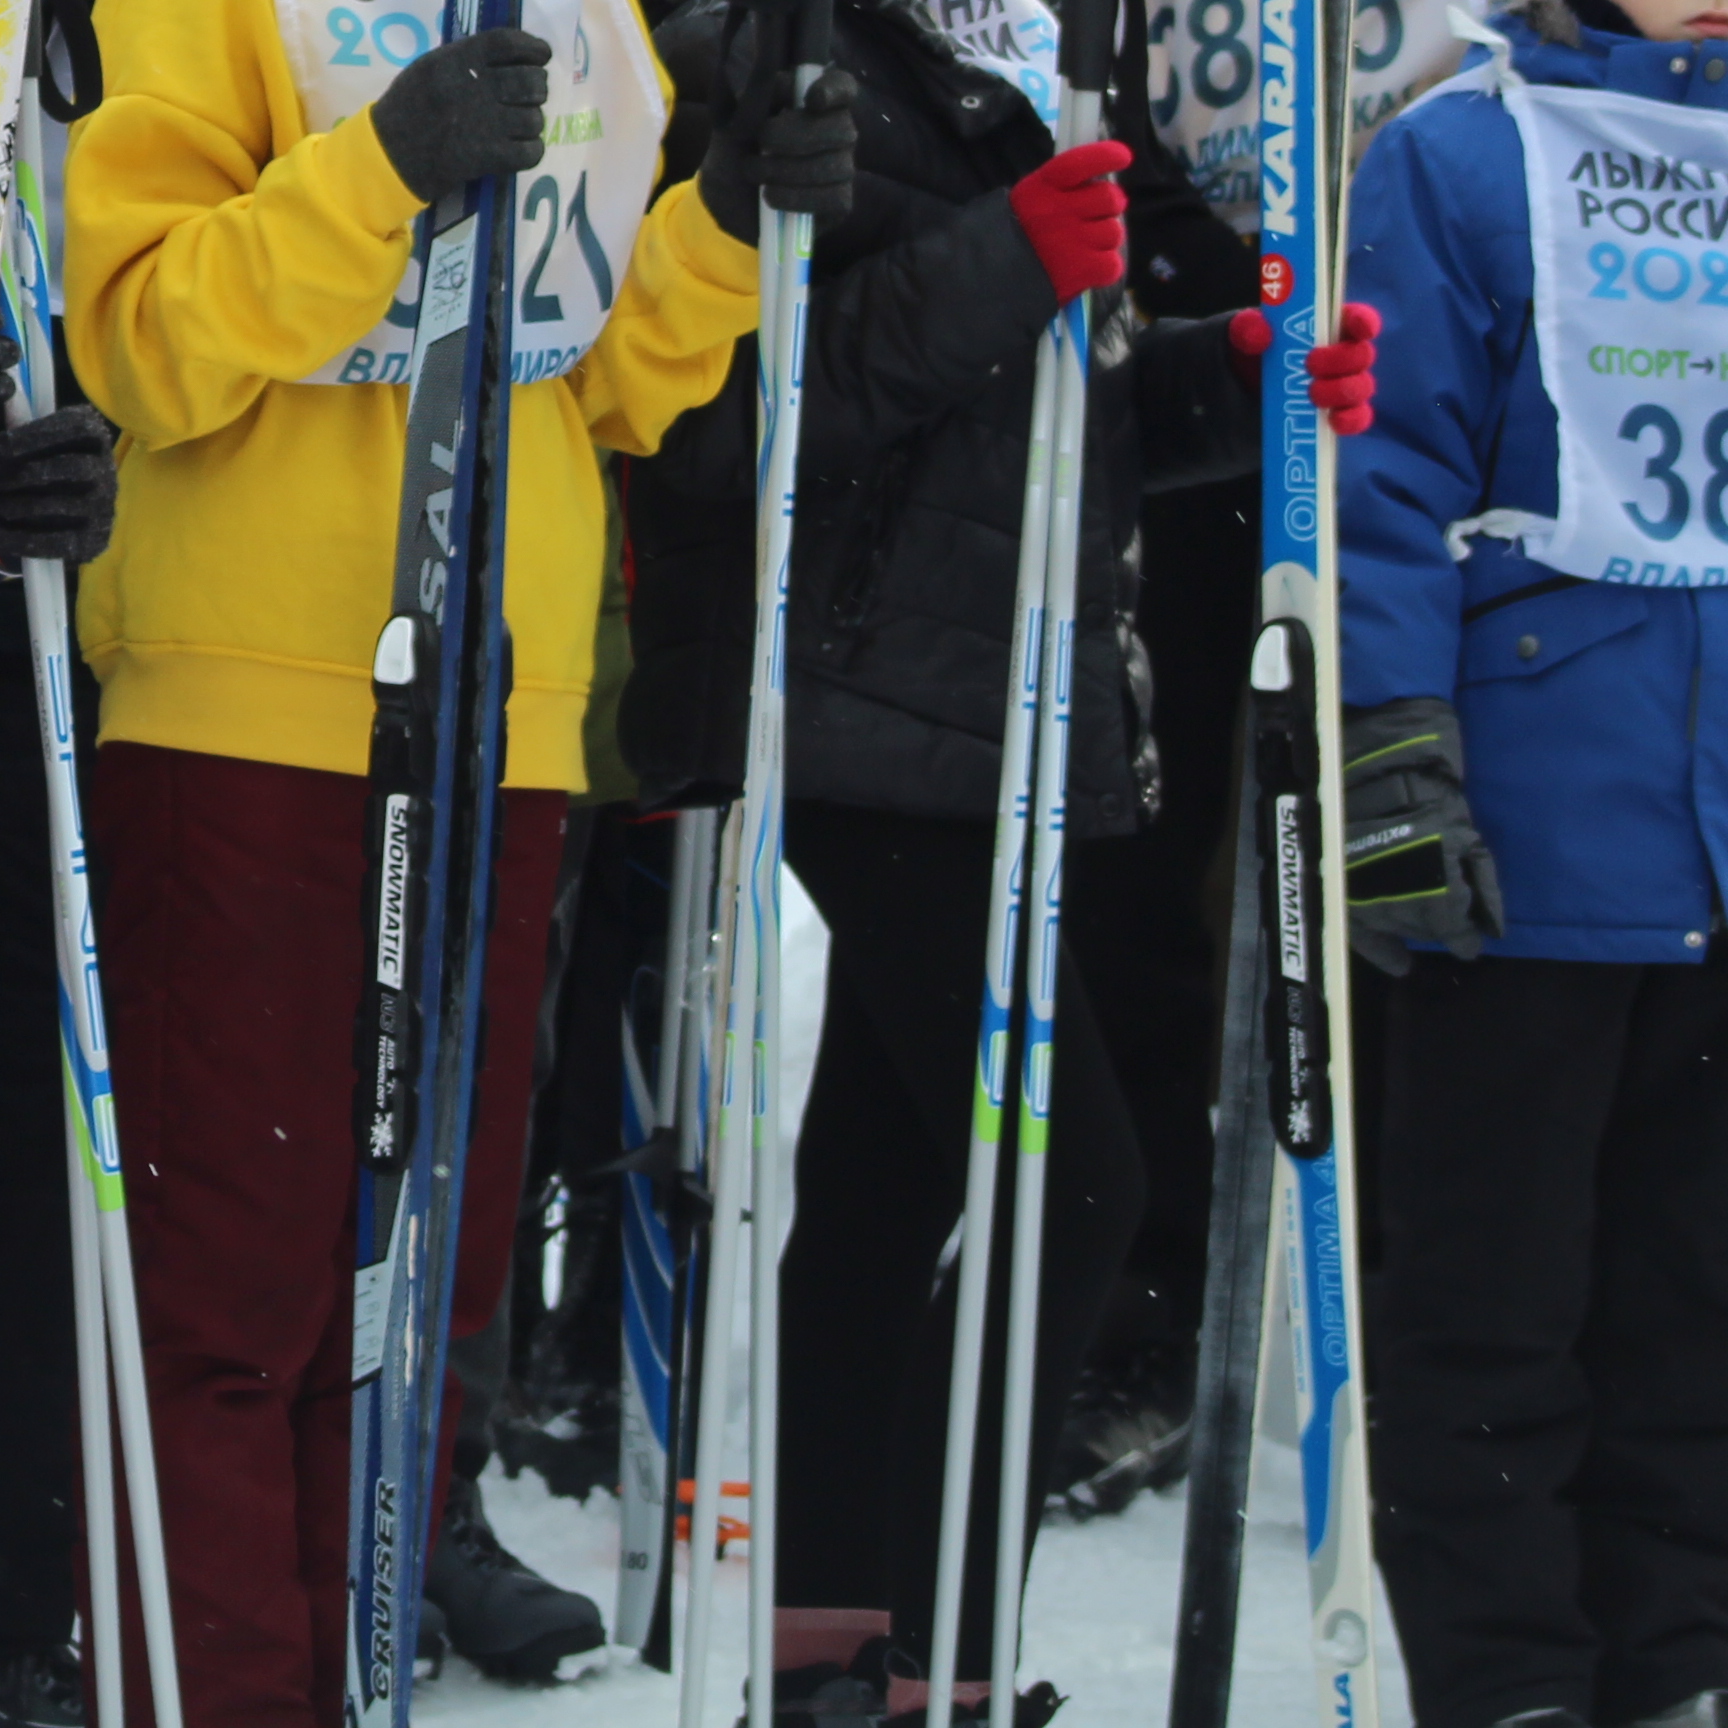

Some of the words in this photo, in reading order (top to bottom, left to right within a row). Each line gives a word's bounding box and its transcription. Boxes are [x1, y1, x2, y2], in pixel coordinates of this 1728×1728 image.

[327, 5, 447, 68] 20
[1263, 260, 1286, 301] 46
[1587, 241, 1728, 307] 202
[1587, 344, 1691, 378] СПОРТ
[1282, 305, 1318, 543] OPTIMA
[382, 803, 408, 974] SNOWMATIC
[1279, 805, 1302, 970] SNOWMATIC
[376, 1035, 388, 1109] TECHNOLOGY
[385, 1038, 396, 1072] AUTO
[369, 1476, 398, 1702] CRUISER
